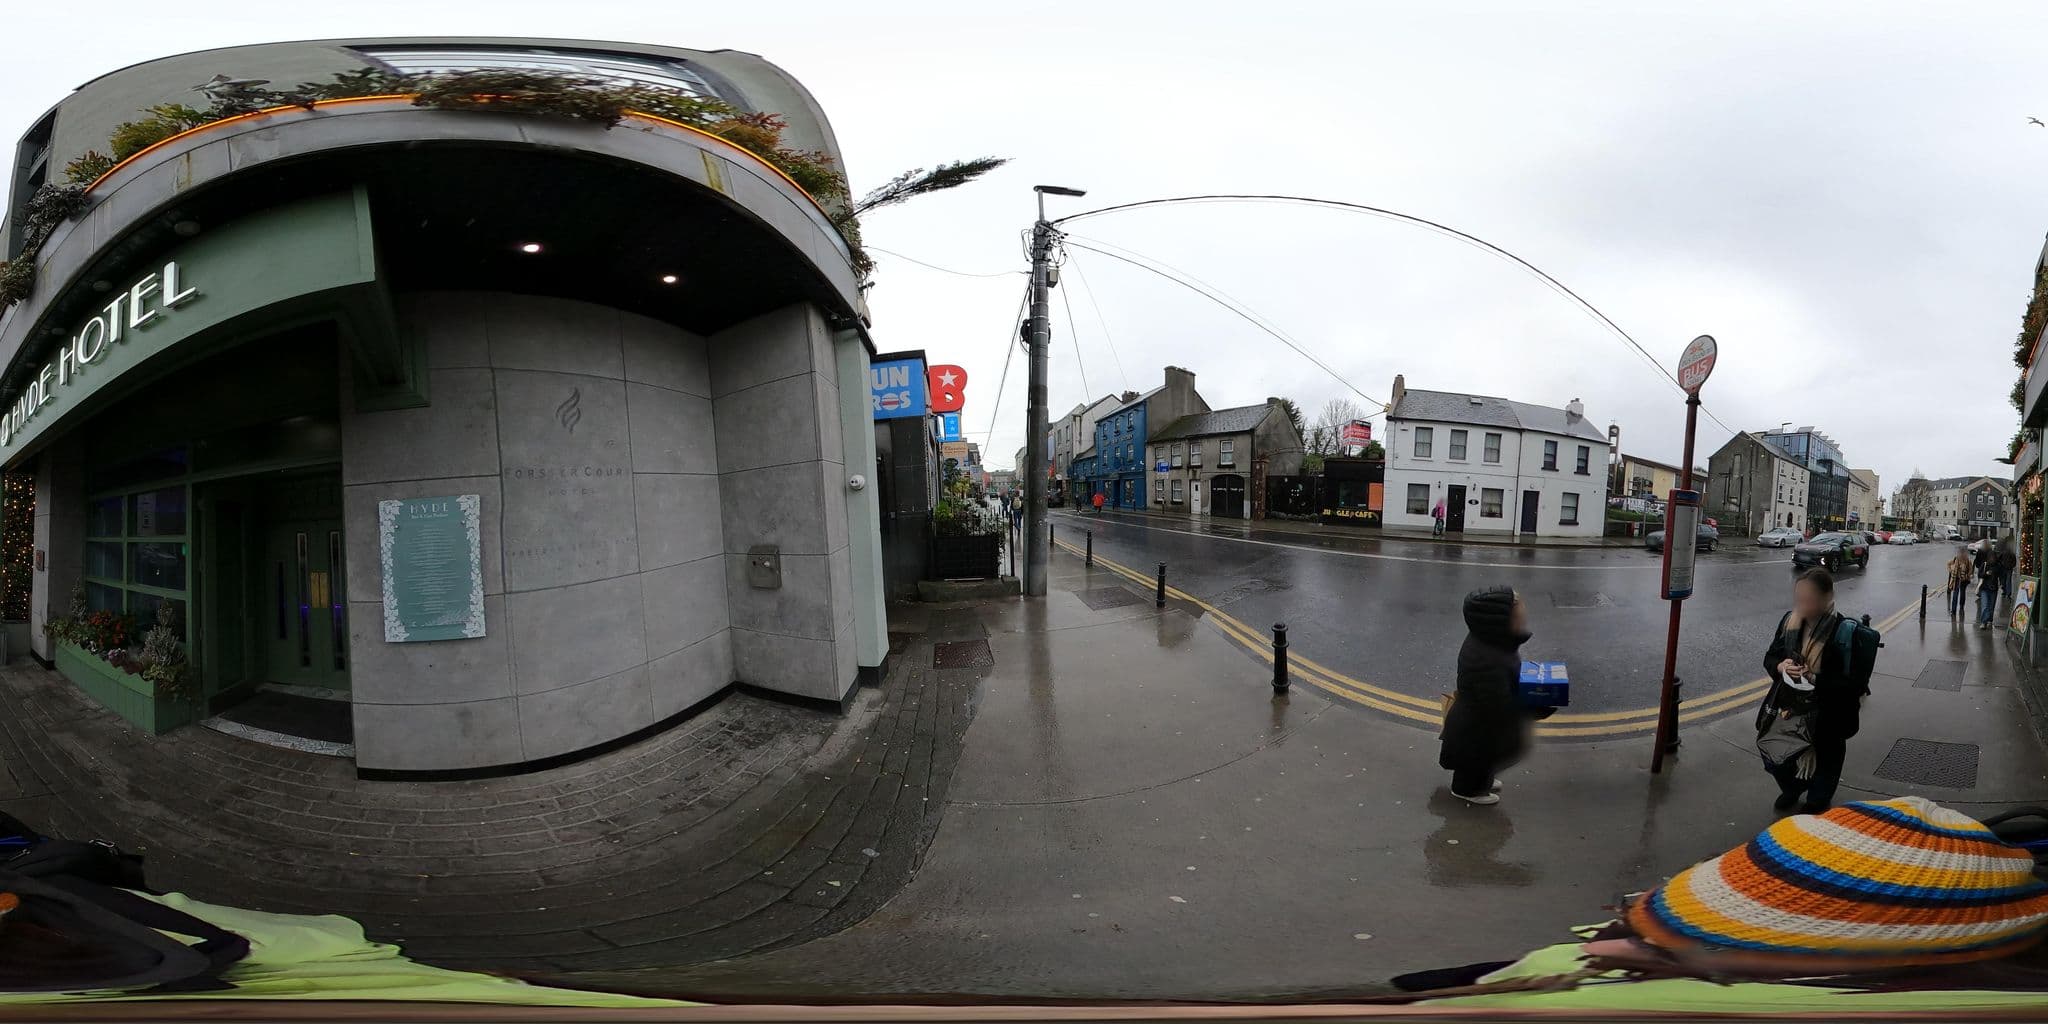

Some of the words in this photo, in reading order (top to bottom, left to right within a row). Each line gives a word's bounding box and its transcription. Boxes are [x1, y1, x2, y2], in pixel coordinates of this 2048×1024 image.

[11, 363, 54, 434] HYDE
[59, 261, 198, 385] HOTEL
[871, 366, 909, 390] UN
[1684, 359, 1708, 381] BUS
[410, 502, 448, 514] HYDE
[1322, 508, 1350, 517] JUGLE
